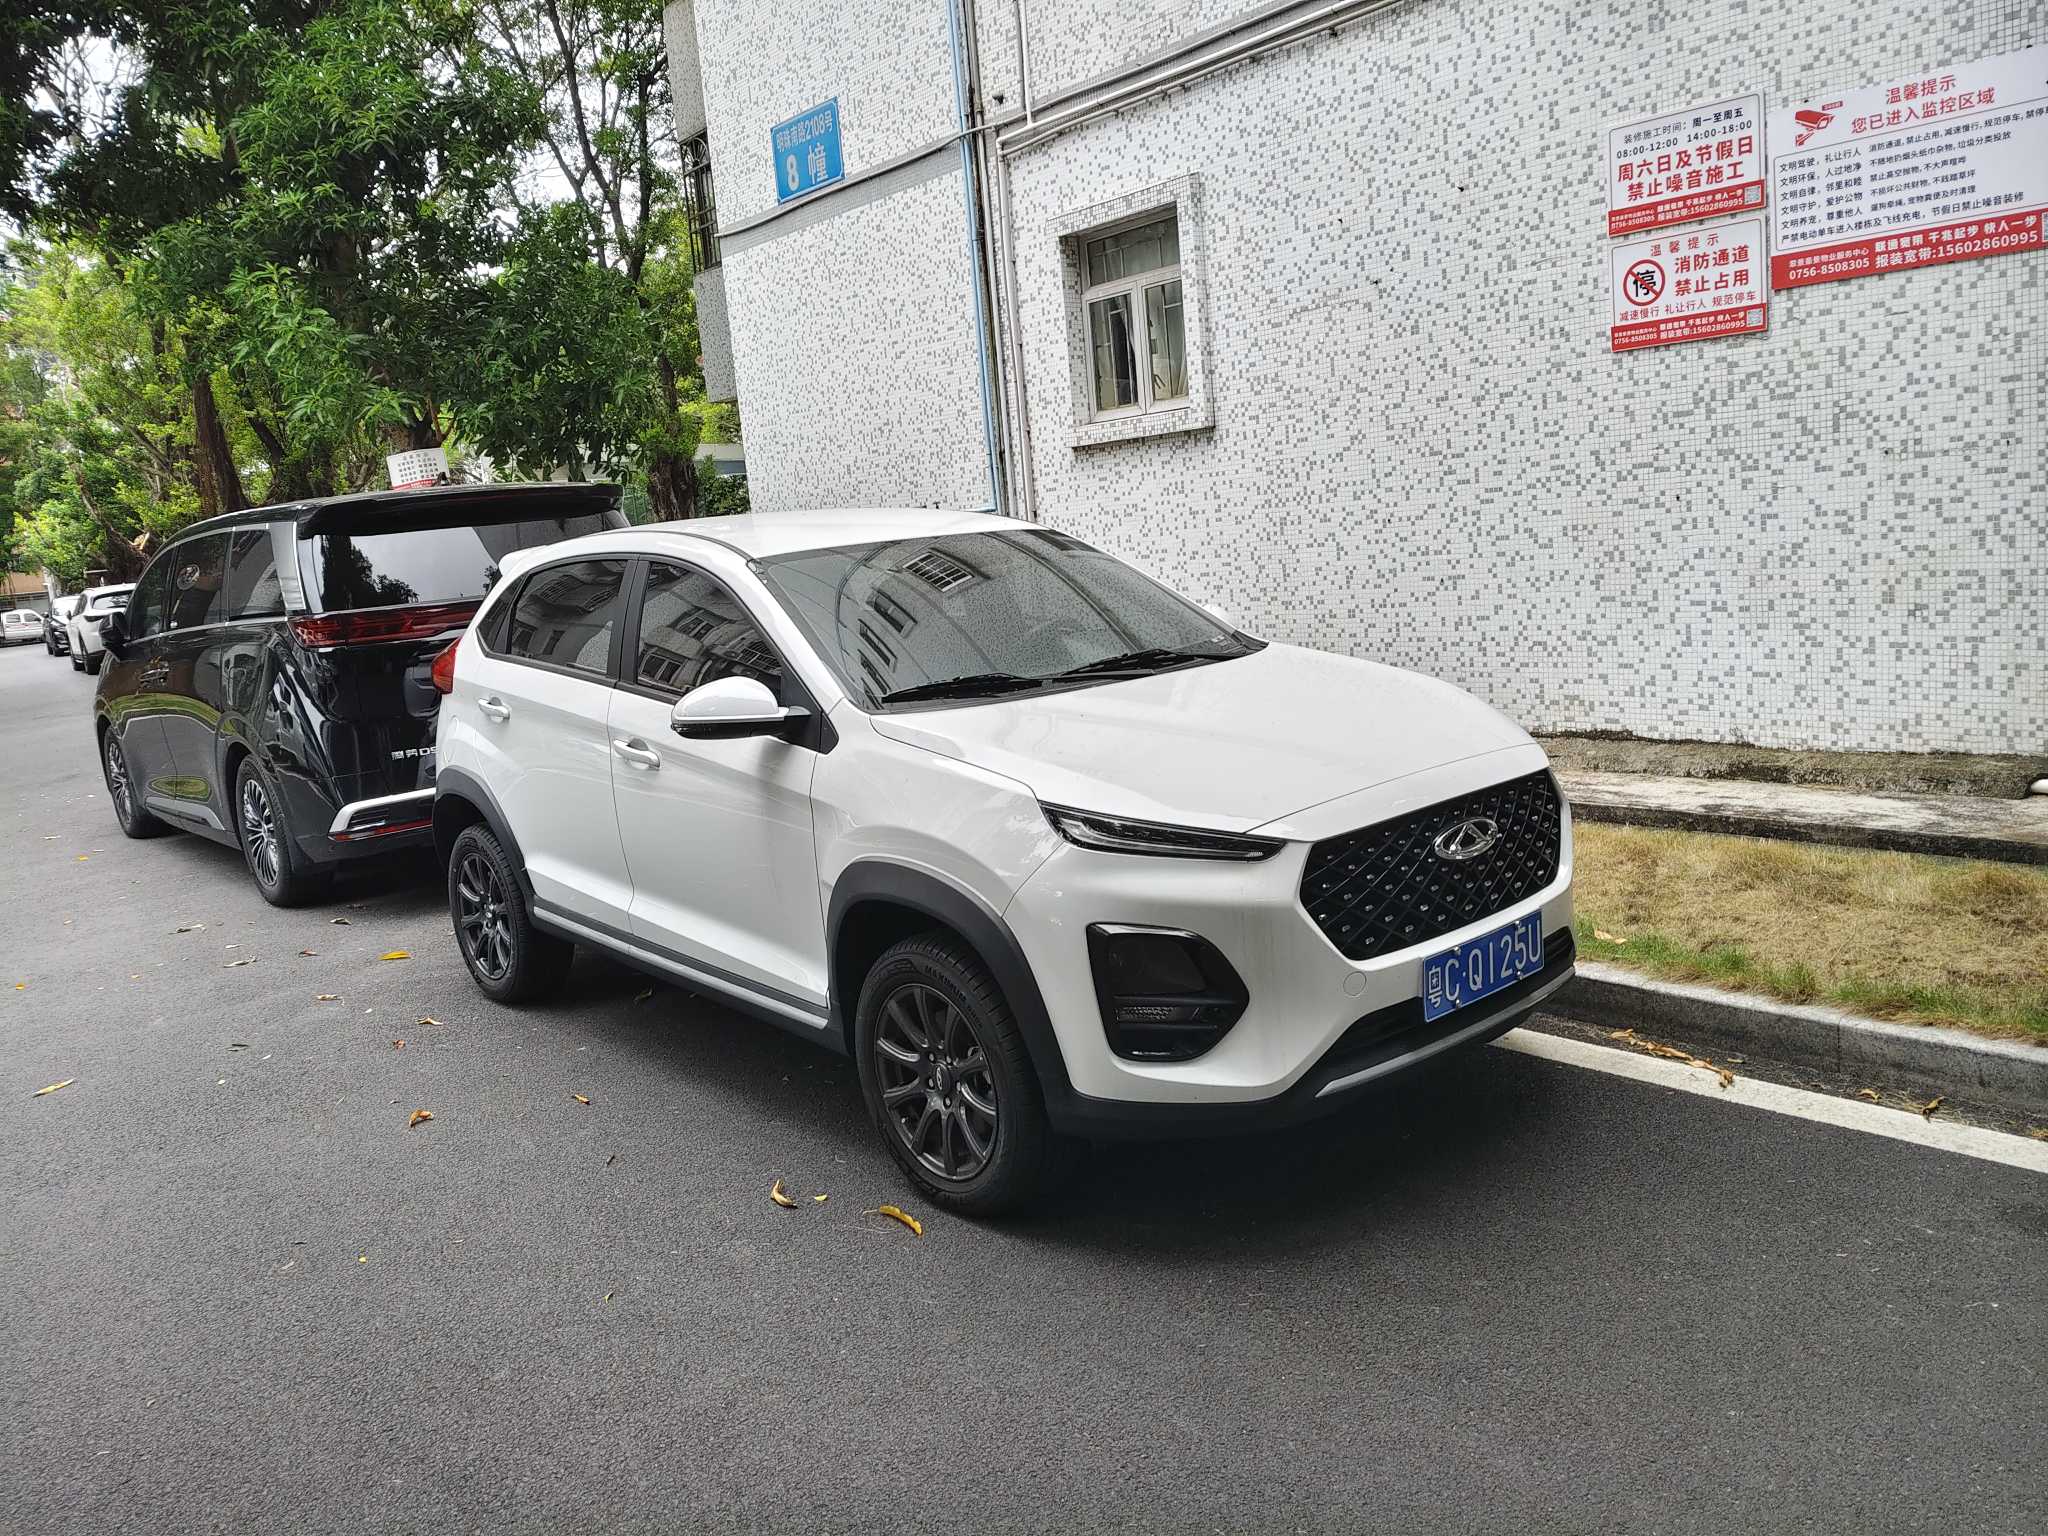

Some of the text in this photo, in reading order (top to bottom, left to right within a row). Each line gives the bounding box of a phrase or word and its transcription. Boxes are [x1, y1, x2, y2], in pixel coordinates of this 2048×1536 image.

[1886, 74, 1957, 104] 温馨提示
[1692, 107, 1743, 128] 周一至周五
[1851, 87, 1996, 134] 您已进入监控区域
[1616, 120, 1752, 159] 08:00-12:00 14:00-18:00
[786, 141, 829, 191] 8 幢
[1618, 135, 1753, 182] 周六日及节假日
[1627, 161, 1744, 201] 禁止噪音施工
[1650, 233, 1719, 257] 温馨提示
[1674, 245, 1749, 274] 消防通道
[1633, 269, 1657, 298] 停
[1675, 269, 1749, 297] 禁止占用
[1789, 258, 1869, 280] 0756-8508305
[1619, 291, 1757, 321] 减速慢行 礼让行人 规范停车
